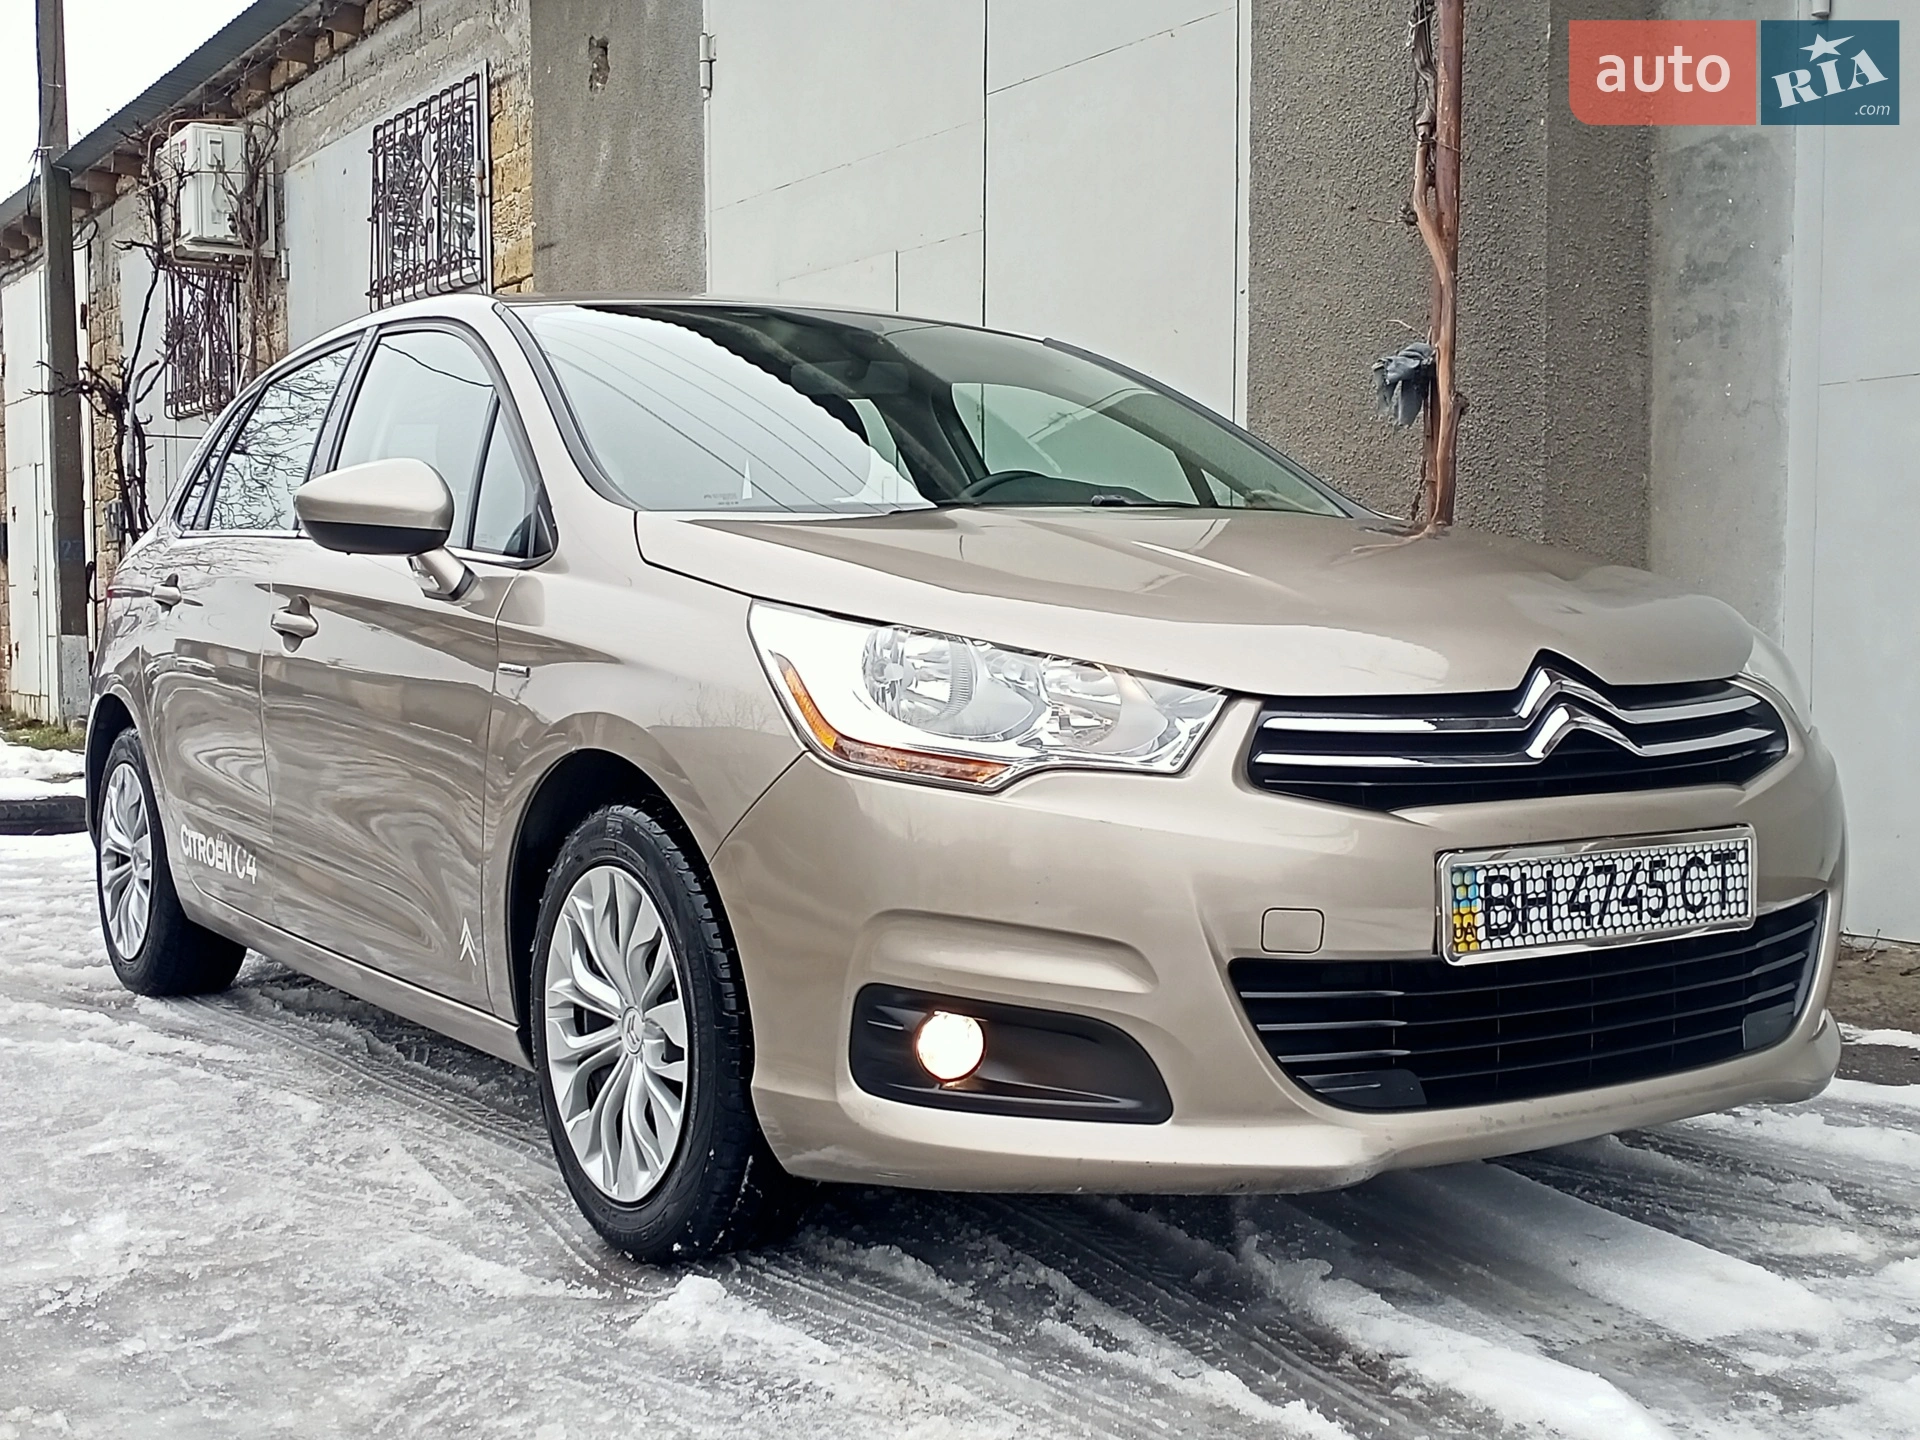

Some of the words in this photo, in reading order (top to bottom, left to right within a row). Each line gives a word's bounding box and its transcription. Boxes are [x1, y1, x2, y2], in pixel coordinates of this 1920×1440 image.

[181, 824, 232, 874] CITROËN
[235, 845, 257, 885] C4
[1567, 859, 1667, 928] 4745
[1453, 922, 1475, 939] UA
